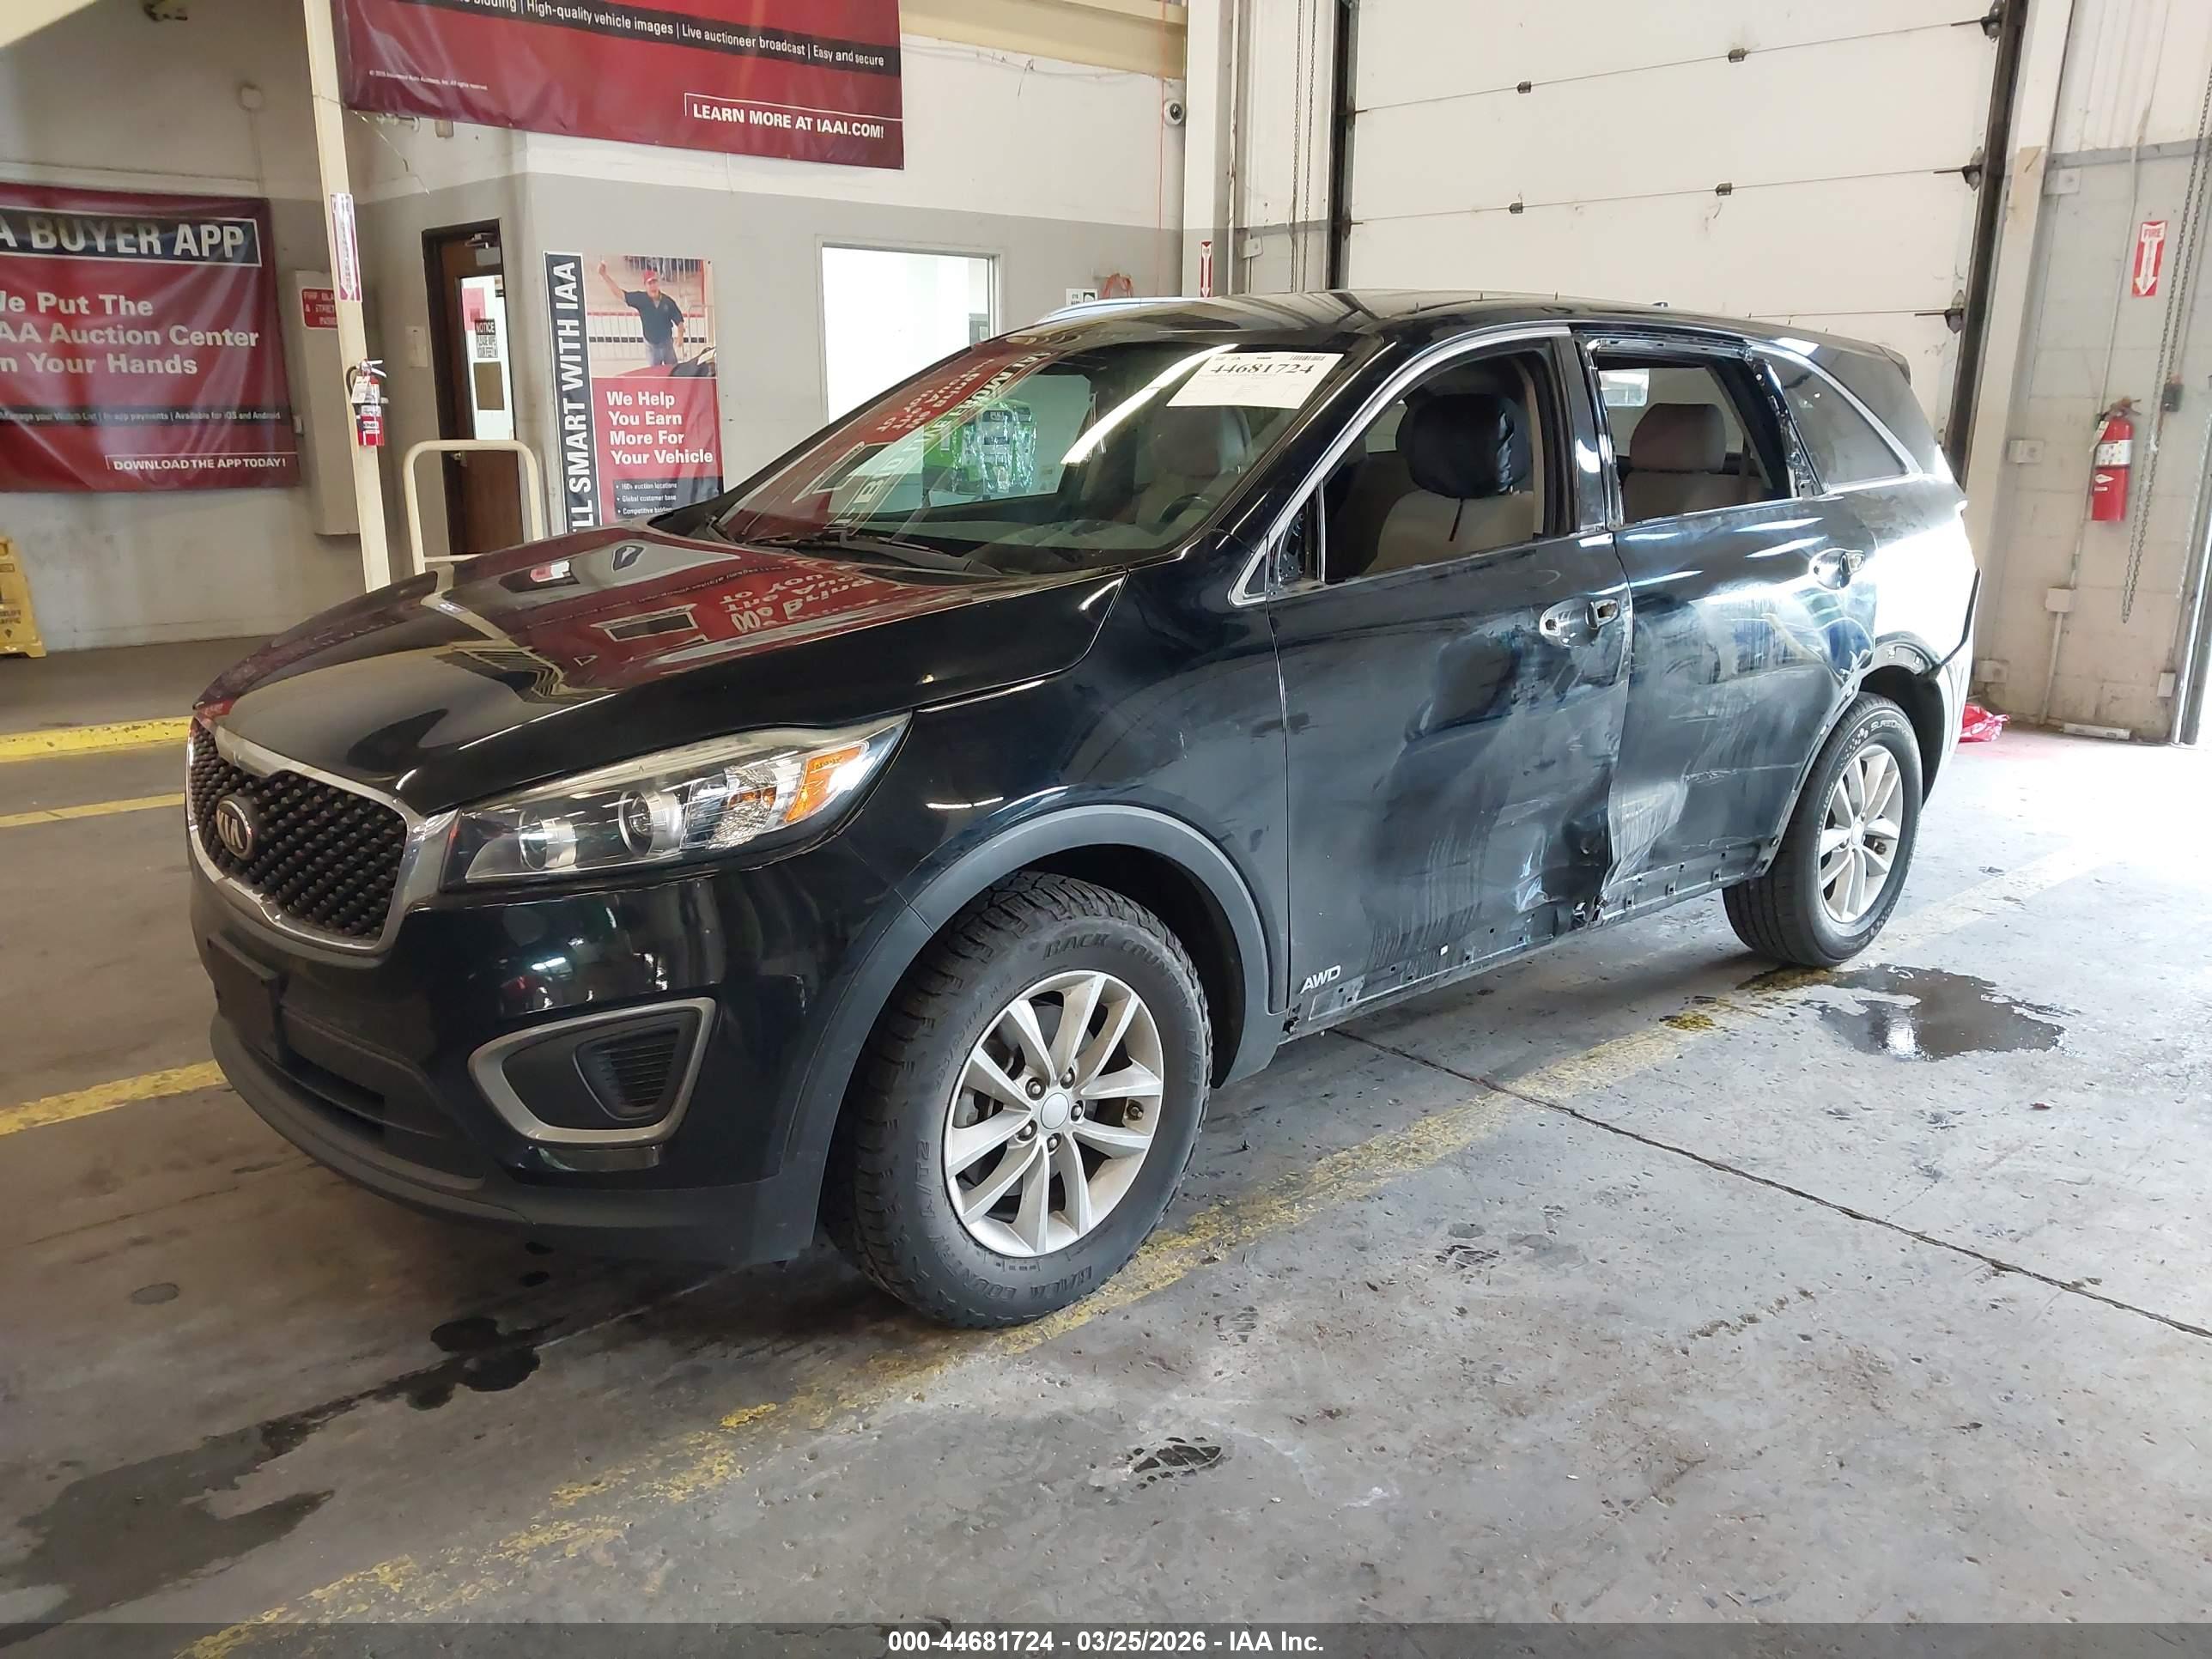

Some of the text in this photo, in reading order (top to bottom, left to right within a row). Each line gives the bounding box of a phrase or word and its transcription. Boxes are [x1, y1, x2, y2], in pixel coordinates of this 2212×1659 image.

[527, 0, 592, 24] High-quality
[594, 13, 631, 29] vehicle
[634, 16, 673, 36] images
[682, 23, 702, 40] Live
[704, 31, 757, 48] auctioneer
[759, 35, 805, 56] broadcast
[813, 45, 833, 63] Easy
[836, 50, 854, 63] and
[855, 52, 884, 67] secure
[693, 103, 884, 139] LEARN MORE AT IAAI.COM!
[27, 216, 163, 256] BUYER
[173, 223, 245, 258] APP
[2143, 228, 2162, 239] FIRE
[36, 291, 90, 314] Put
[98, 294, 153, 316] The
[49, 322, 161, 345] Auction
[169, 325, 259, 347] Center
[27, 352, 96, 374] Your
[106, 353, 198, 374] Hands
[1211, 363, 1315, 374] 44681724
[552, 261, 594, 532] LL SMART WITH IAA
[606, 391, 676, 409] We Help
[130, 412, 168, 422] payments
[608, 410, 683, 426] You Earn
[610, 429, 684, 445] More For
[113, 458, 286, 471] DOWNLOAD THE APP TODAY!
[611, 449, 714, 465] Your Vehicle
[1299, 965, 1341, 994] AWD
